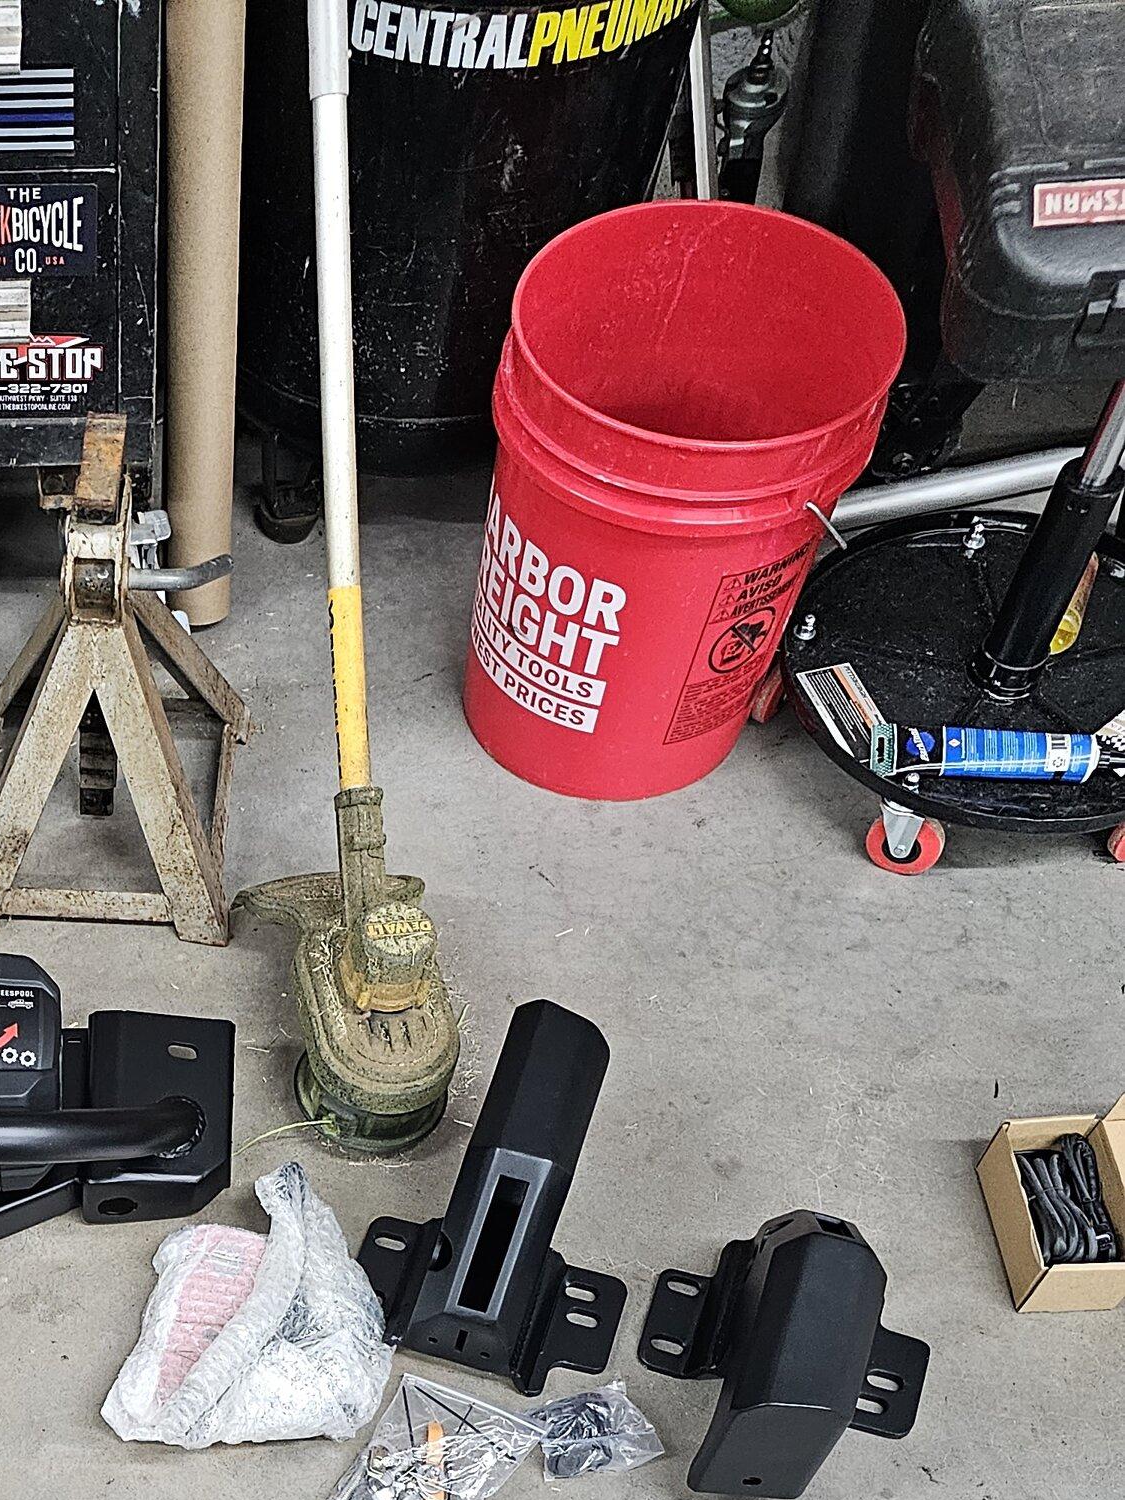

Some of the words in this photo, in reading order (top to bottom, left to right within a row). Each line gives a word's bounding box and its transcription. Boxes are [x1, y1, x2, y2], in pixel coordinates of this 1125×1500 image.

[351, 0, 528, 69] CENTRAL
[527, 0, 694, 67] PNEUMA
[7, 187, 42, 203] THE
[11, 197, 84, 252] BICYCLE
[15, 248, 43, 273] CO.
[45, 256, 65, 266] USA
[28, 347, 103, 380] STOP
[486, 476, 626, 632] ARBOR
[479, 540, 619, 676] REIGHT
[737, 574, 783, 601] AVISO
[475, 592, 511, 653] ALITY
[517, 648, 594, 699] TOOLS
[503, 674, 587, 726] PRICES
